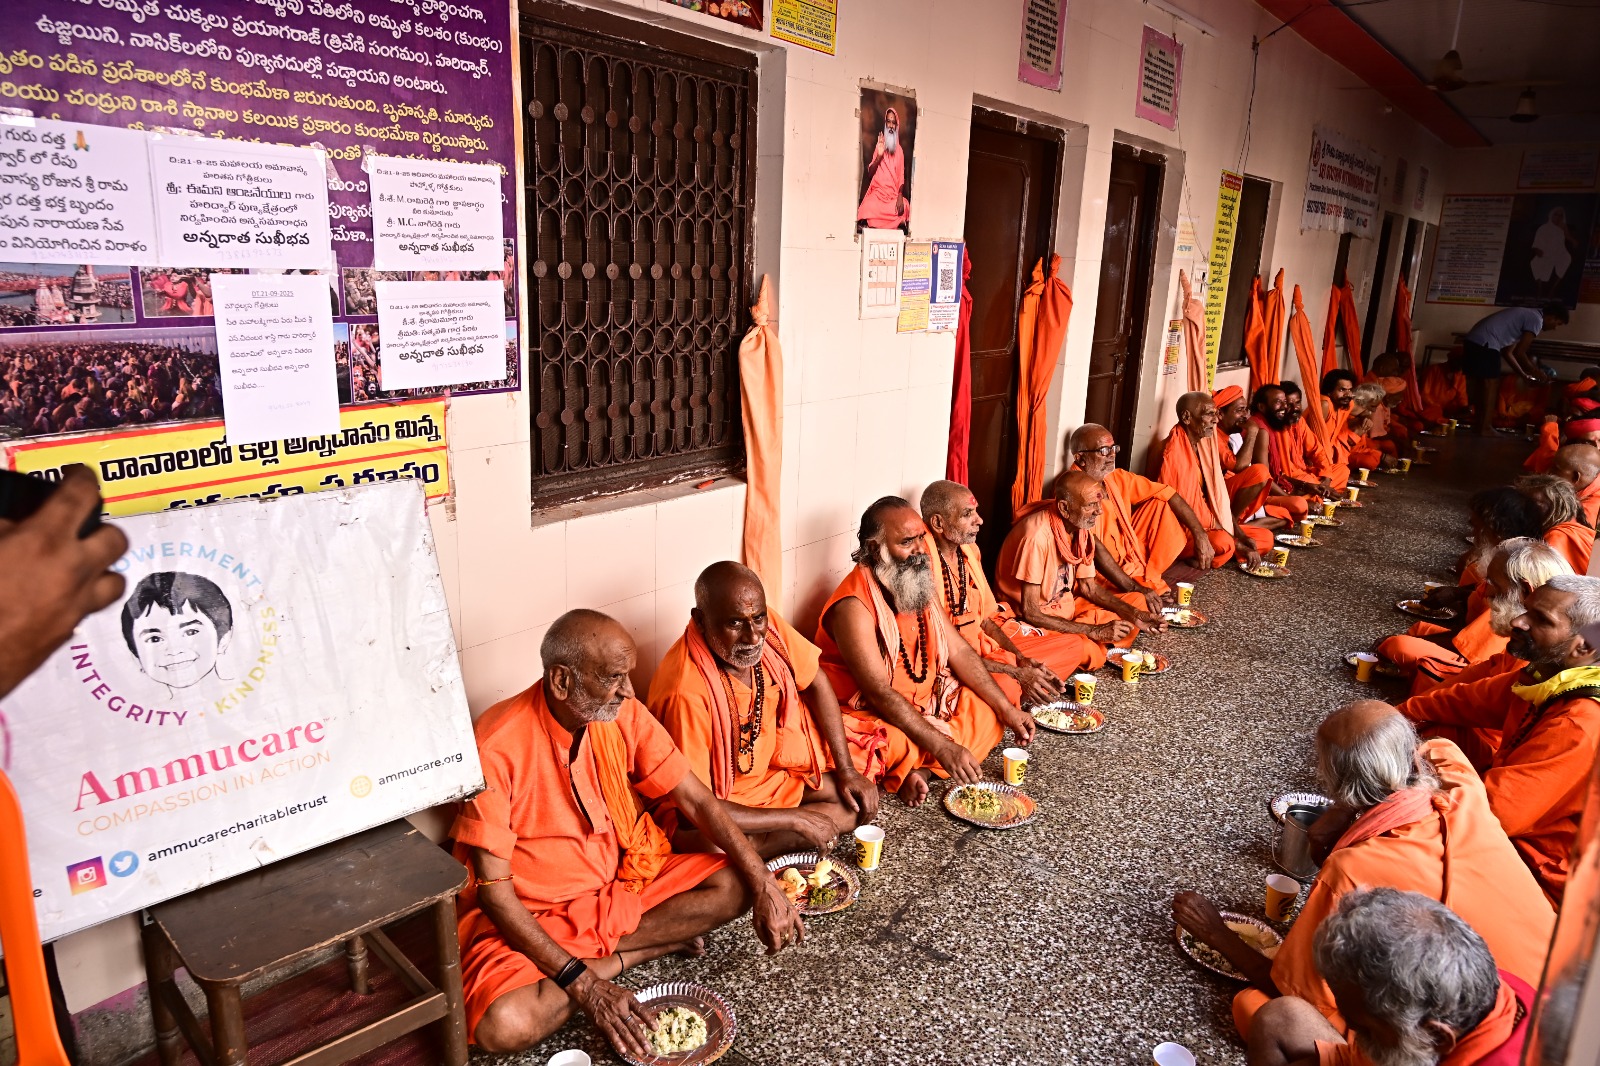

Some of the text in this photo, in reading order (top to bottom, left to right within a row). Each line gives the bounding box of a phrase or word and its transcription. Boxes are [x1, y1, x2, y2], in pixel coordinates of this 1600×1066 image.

[164, 4, 229, 33] చుక్కలు
[232, 16, 321, 46] ప్రయాగరాజ్
[368, 41, 433, 67] సంగమం),
[368, 15, 412, 39] అమృత
[414, 22, 451, 41] కలశం
[455, 30, 503, 53] (కుంభం)
[35, 14, 125, 46] ఉజ్జయిని,
[326, 62, 390, 88] పడ్డాయని
[393, 74, 448, 95] అంటారు.
[49, 54, 98, 76] పడిన
[102, 60, 207, 90] ప్రదేశాలలోనే
[210, 77, 290, 101] కుంభమేళా
[294, 90, 380, 113] జరుగుతుంది.
[444, 110, 494, 132] సూర్యుడు
[64, 88, 137, 114] చంద్రుని
[140, 98, 179, 116] రాశి
[183, 101, 238, 130] స్థానాల
[242, 110, 299, 129] కలయిక
[302, 116, 352, 136] ప్రకారం
[354, 123, 419, 142] కుంభమేళా
[5, 128, 66, 150] గురు దత్త
[30, 151, 48, 165] లో
[51, 153, 77, 169] రేపు
[42, 173, 82, 189] రోజున
[86, 176, 95, 193] శ్రీ
[98, 180, 128, 192] రామ
[16, 195, 41, 211] దత్త
[70, 199, 114, 215] బృందం
[33, 217, 99, 230] నారాయణ
[102, 217, 124, 232] సేవ
[183, 229, 310, 248] అన్నదాత సుఖీభవ
[105, 239, 147, 252] విరాళం
[399, 242, 439, 254] అన్నదాత
[399, 347, 445, 363] అన్నదాత
[395, 414, 443, 442] మిన్న
[114, 541, 262, 588] OWERMENT
[214, 606, 278, 714] KINDNESS
[70, 644, 188, 725] INTEGRITY
[72, 718, 326, 812] Ammucare
[378, 752, 464, 786] ammucare.org
[77, 750, 332, 836] COMPASSION IN ACTION
[147, 795, 329, 862] ammucarecharitabletrust
